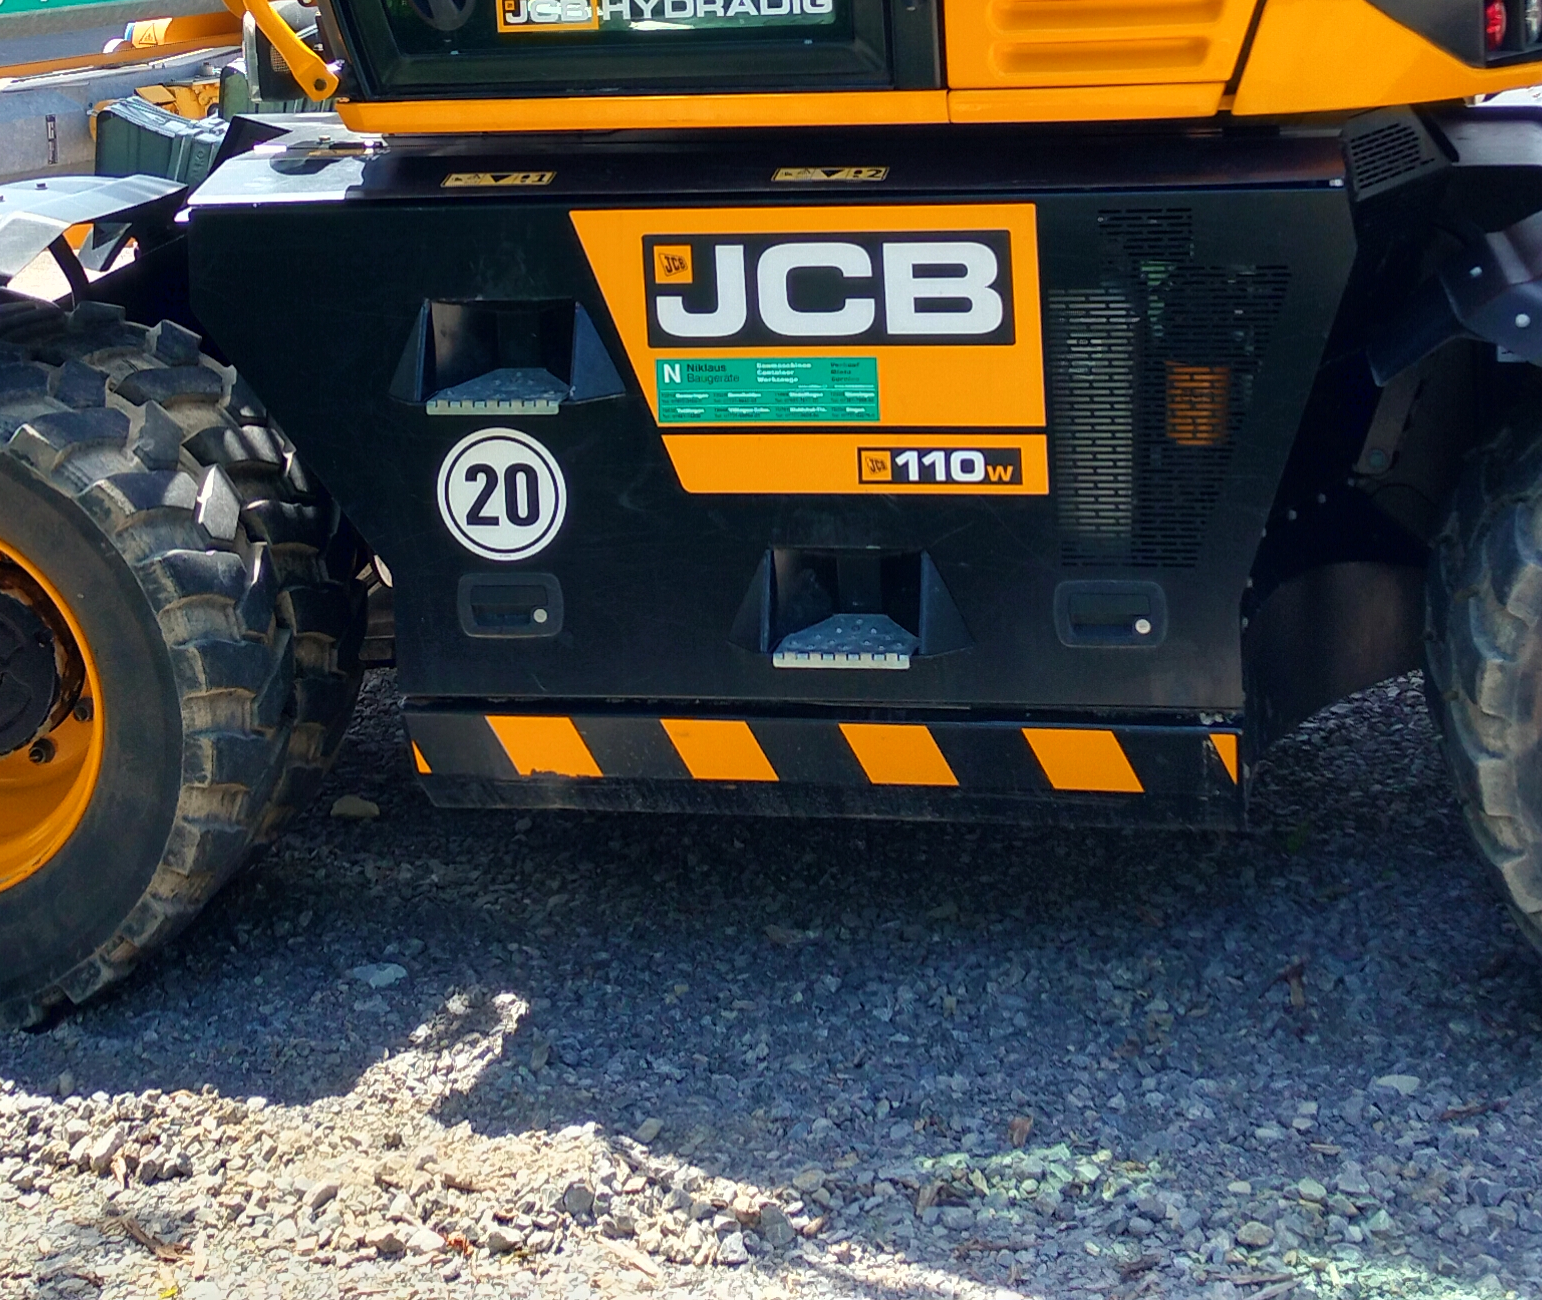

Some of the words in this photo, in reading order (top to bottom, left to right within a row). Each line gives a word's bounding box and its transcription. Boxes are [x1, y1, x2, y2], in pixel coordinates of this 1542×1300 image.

[664, 254, 687, 274] JCB
[656, 242, 1004, 338] JCB
[663, 363, 681, 384] N
[686, 363, 727, 373] Niklaus
[464, 462, 541, 527] 20
